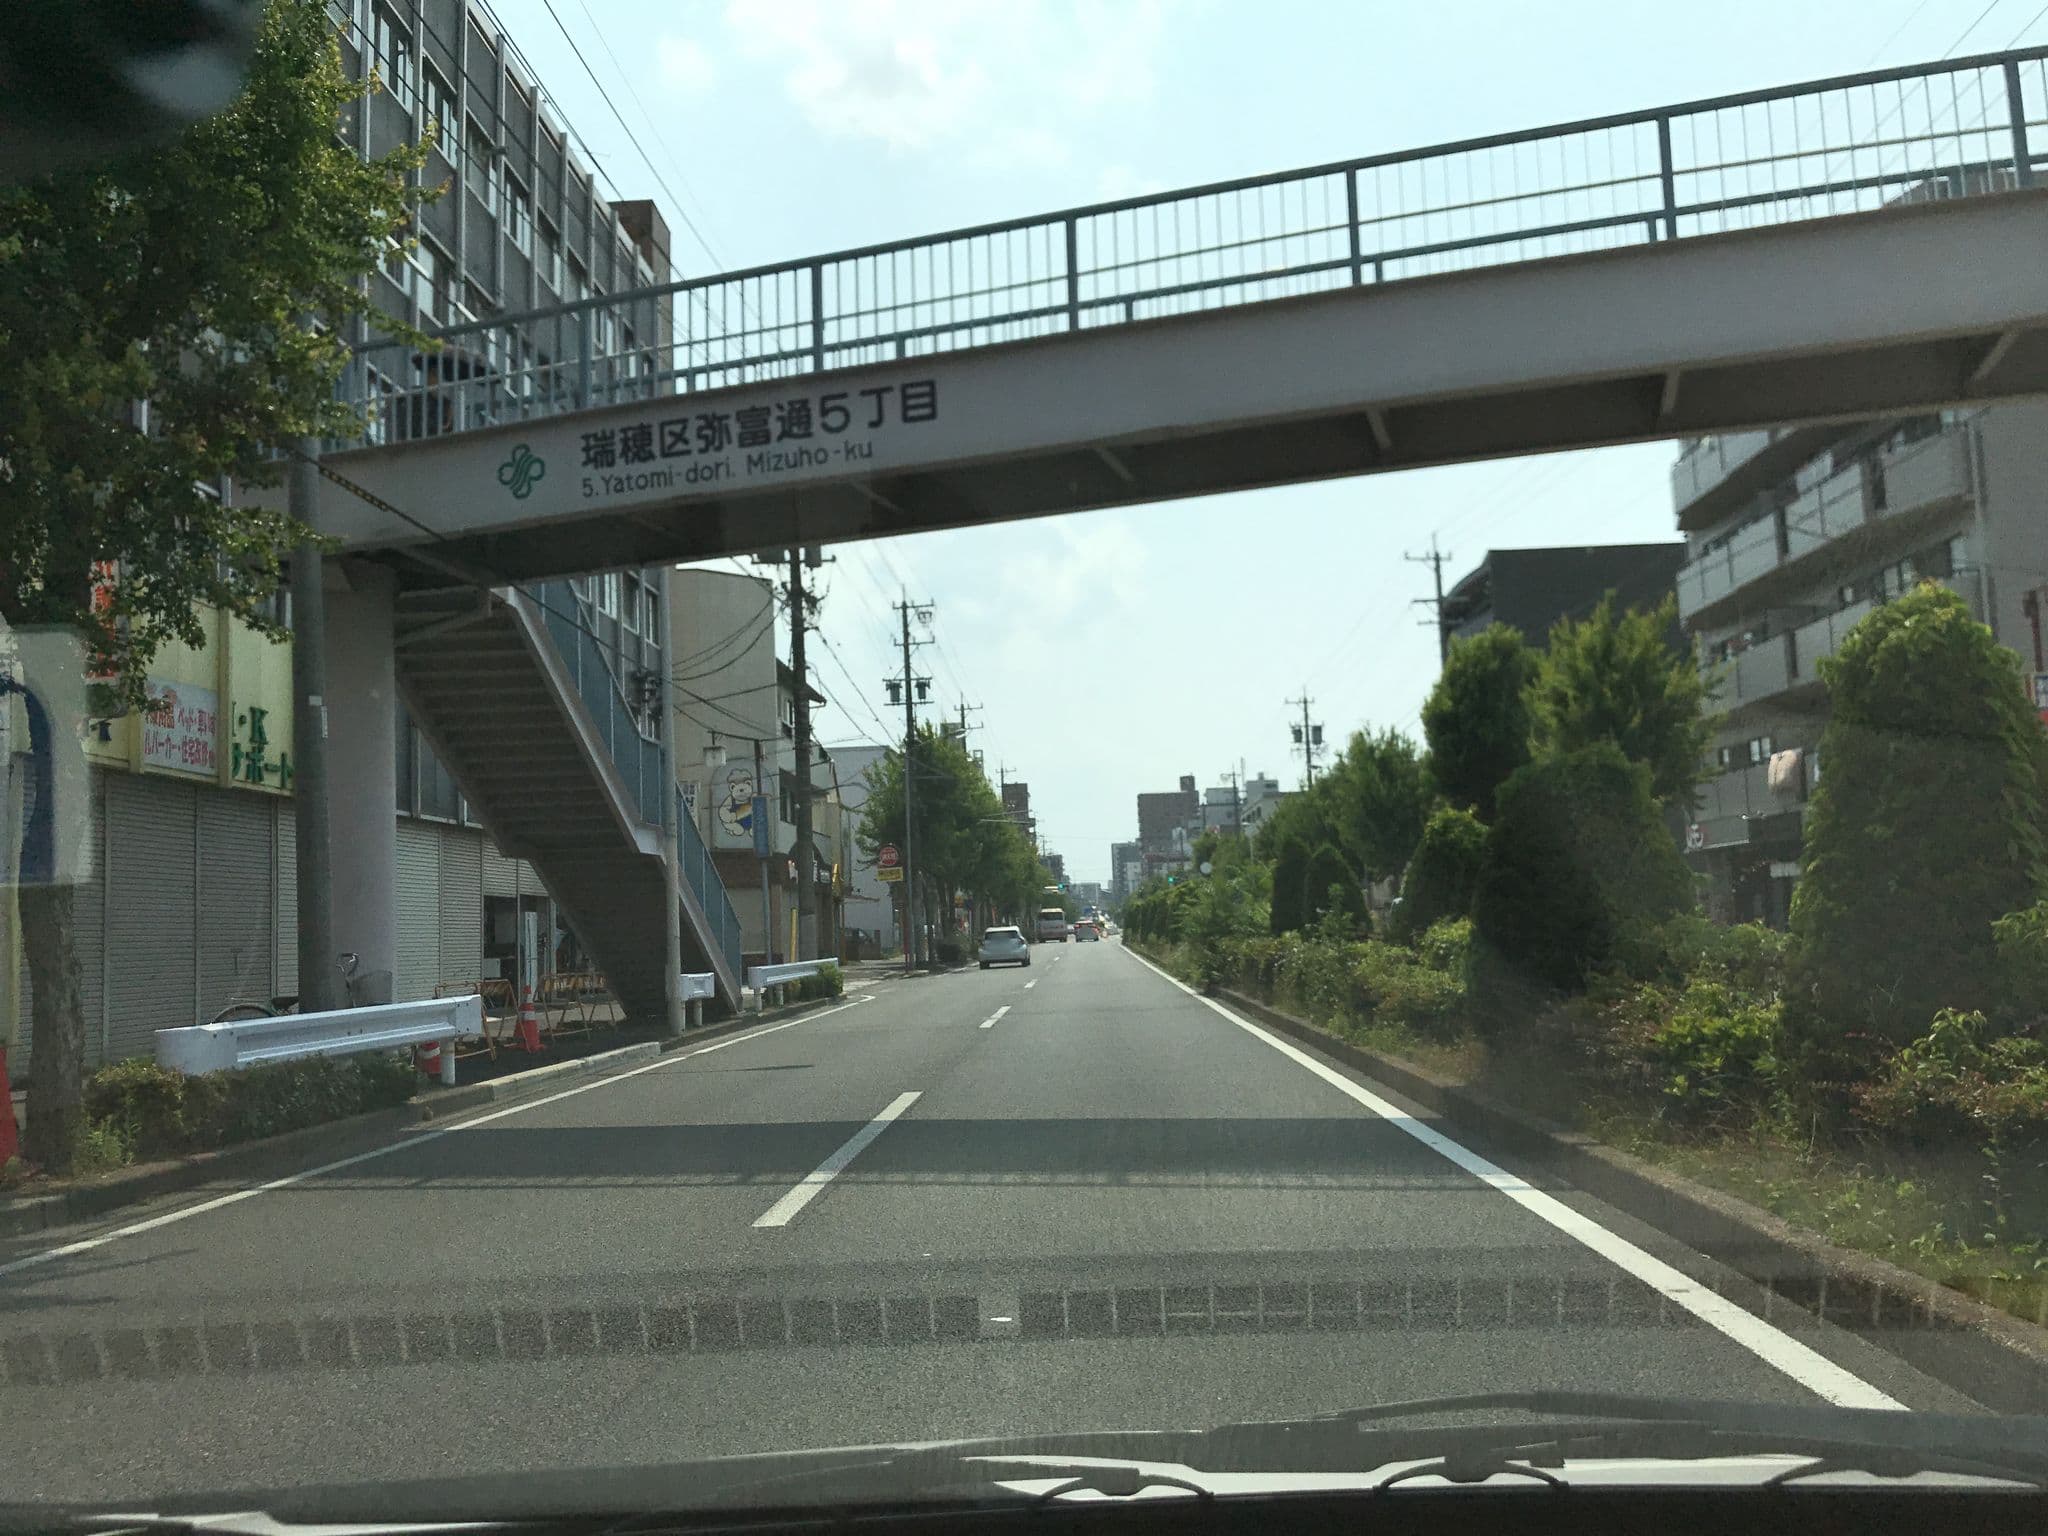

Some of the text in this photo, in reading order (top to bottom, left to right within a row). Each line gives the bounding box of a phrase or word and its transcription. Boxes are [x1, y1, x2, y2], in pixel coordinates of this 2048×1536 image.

[580, 378, 937, 470] 瑞穂区弥富通5丁目
[746, 440, 874, 477] Mizuho-ku
